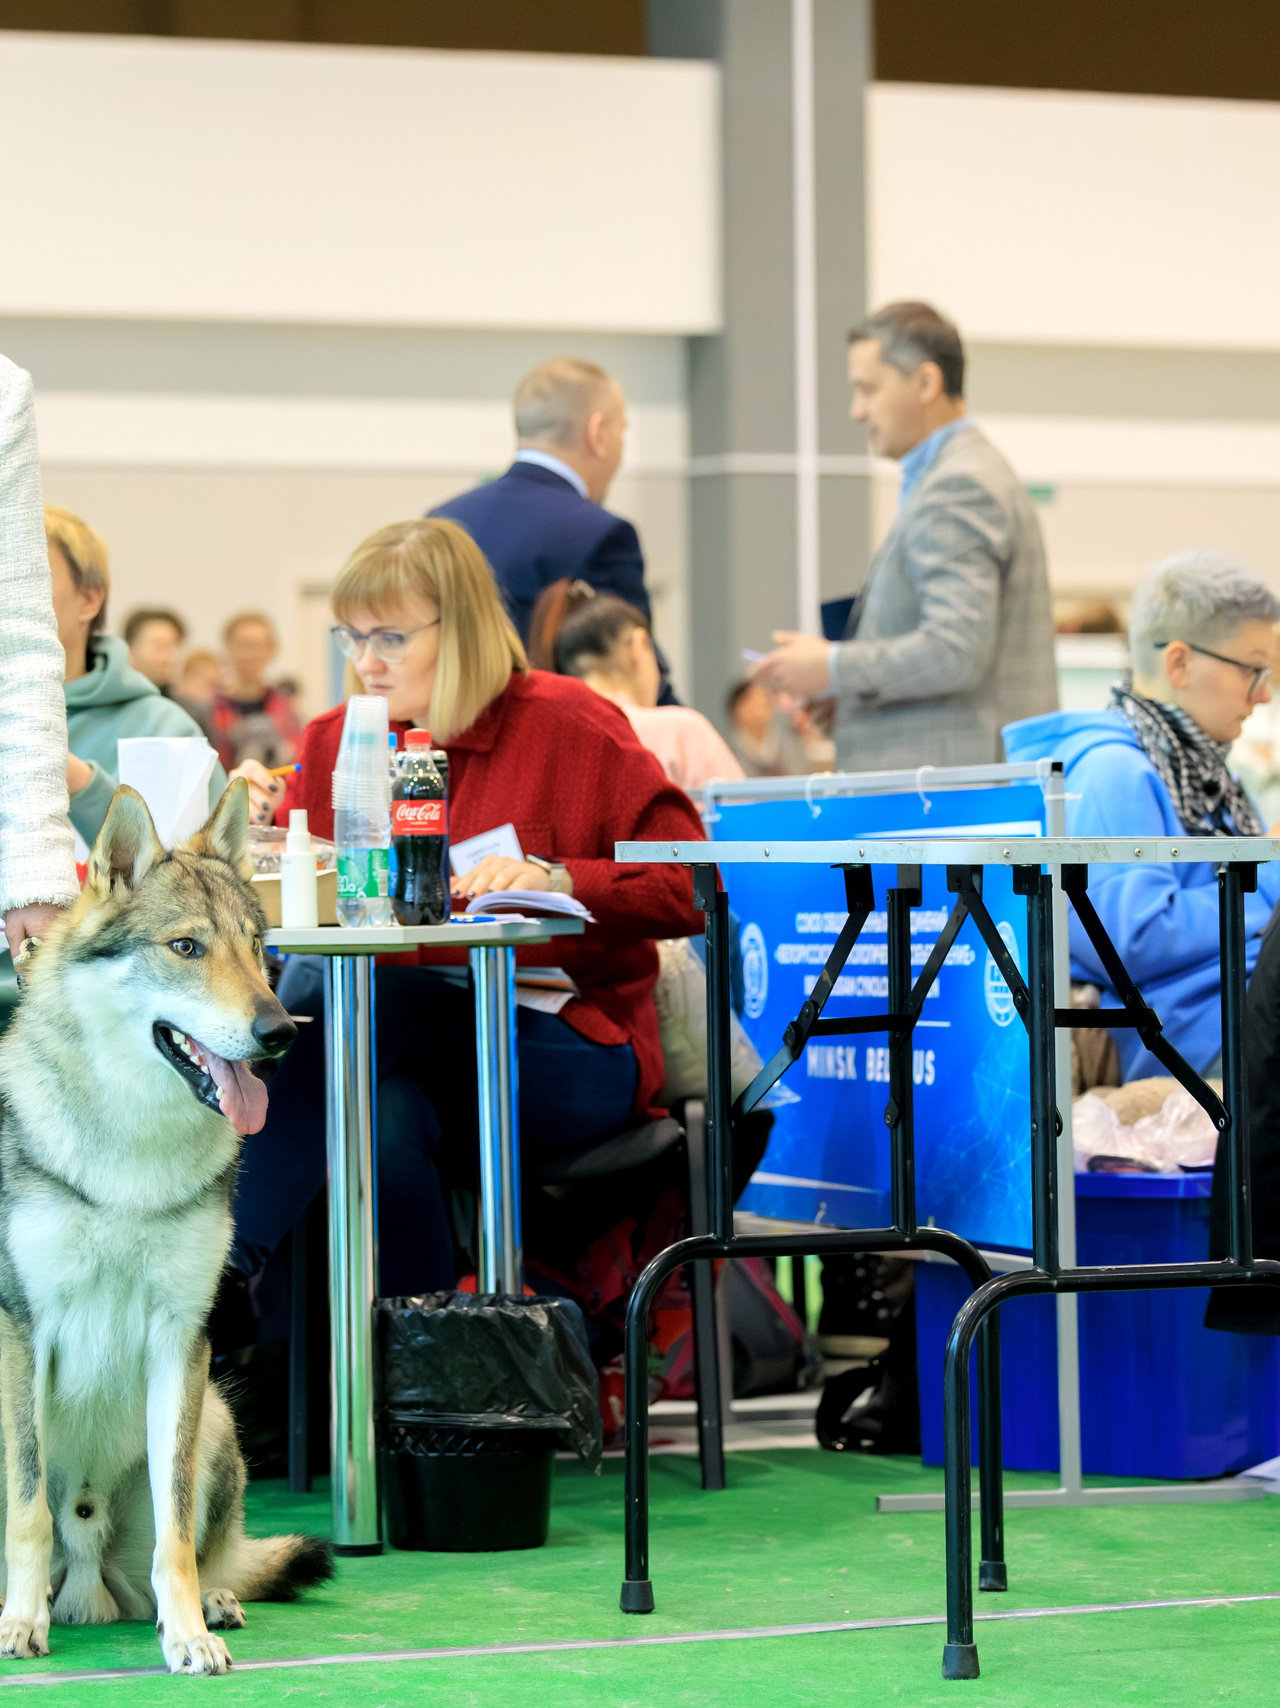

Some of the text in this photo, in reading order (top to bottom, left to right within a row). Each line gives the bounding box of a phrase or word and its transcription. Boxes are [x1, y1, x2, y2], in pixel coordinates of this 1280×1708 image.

[396, 802, 442, 821] Coca-Cola
[807, 1045, 936, 1086] MINSK BELUS
